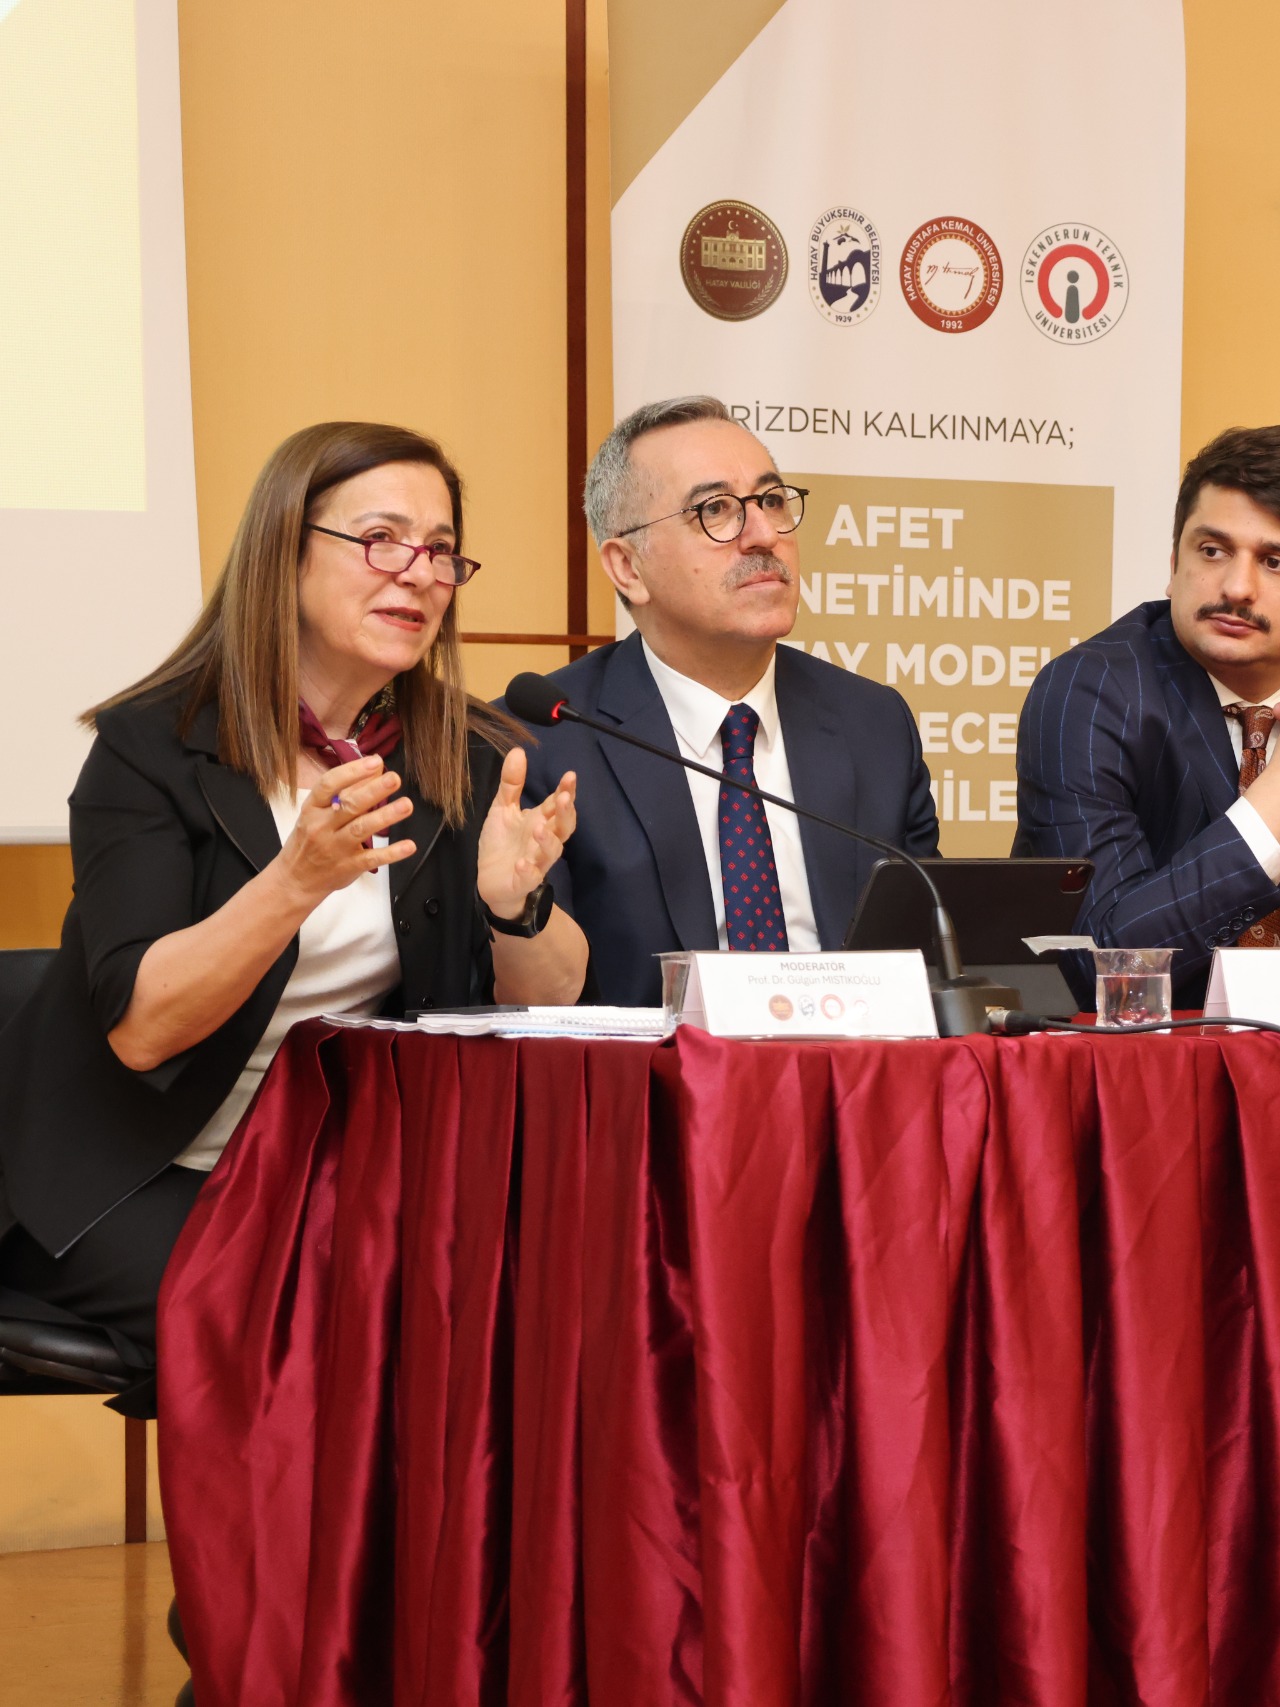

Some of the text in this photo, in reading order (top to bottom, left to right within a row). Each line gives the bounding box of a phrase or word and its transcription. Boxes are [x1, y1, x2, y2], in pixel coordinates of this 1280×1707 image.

[905, 223, 940, 263] MUSTAFA
[940, 220, 975, 236] KEMAL
[705, 280, 728, 288] HATAY
[903, 265, 917, 301] HATAY
[835, 314, 852, 323] 1939
[940, 319, 963, 330] 1992
[728, 400, 1075, 450] RİZDEN KALKINMAYA;
[825, 504, 964, 549] AFET
[797, 564, 1071, 621] NETİMİNDE
[919, 711, 1018, 755] ECE
[930, 769, 1018, 822] İLE
[748, 975, 770, 985] Prof.
[772, 975, 786, 985] Dr.
